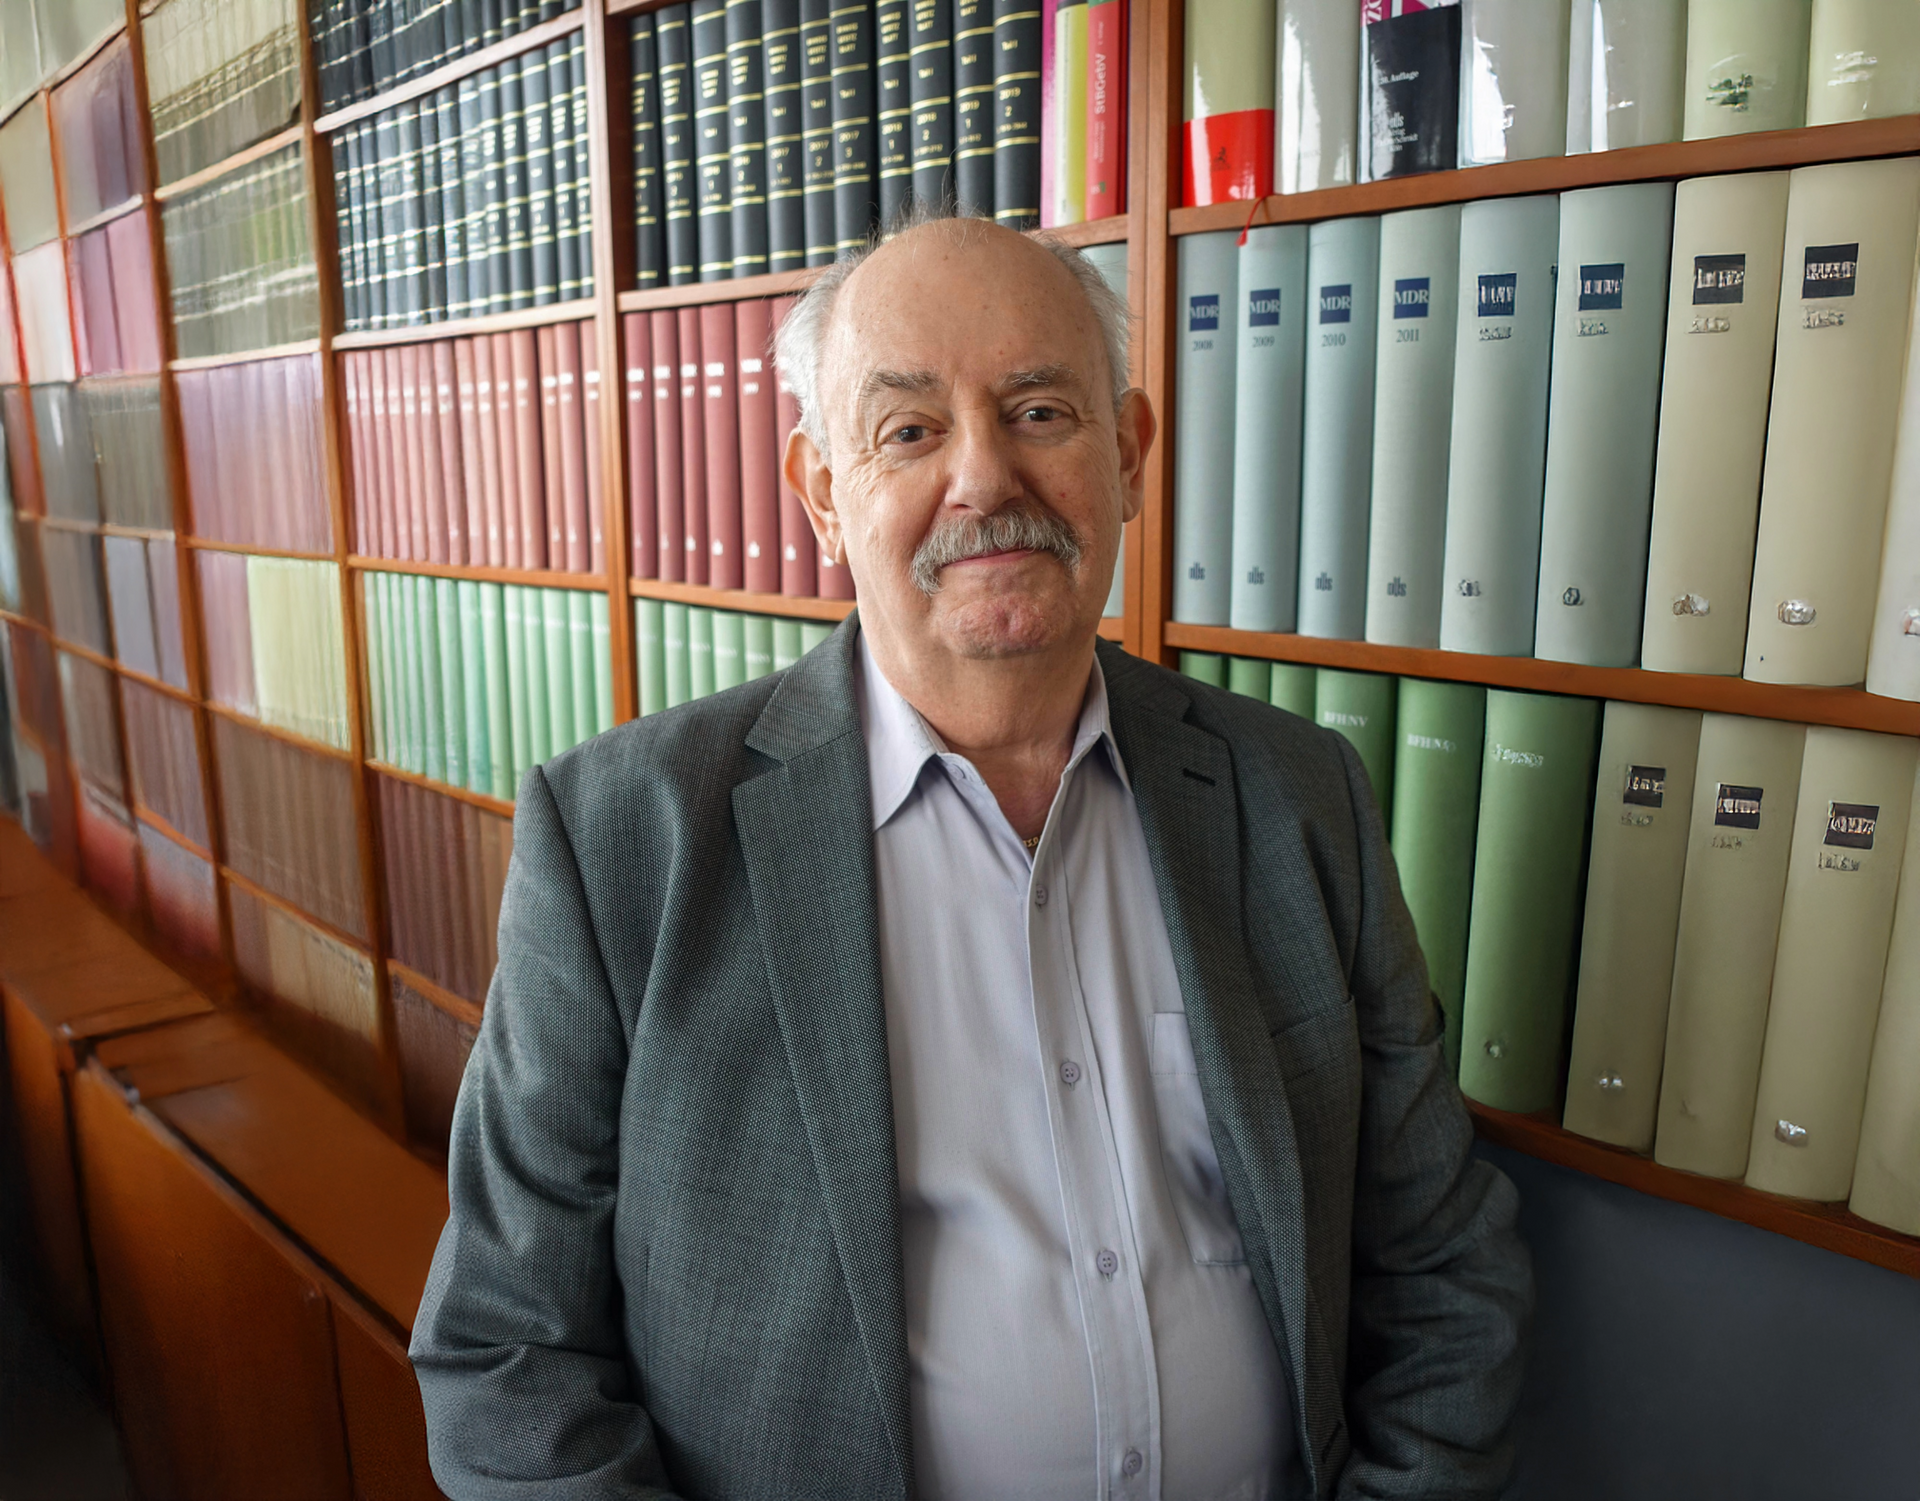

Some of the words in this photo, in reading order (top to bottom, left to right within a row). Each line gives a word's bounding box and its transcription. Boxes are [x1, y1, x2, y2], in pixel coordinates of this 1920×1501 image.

[1320, 296, 1351, 310] MDR
[1394, 289, 1429, 305] MDR
[1190, 305, 1219, 319] MDR
[1249, 299, 1280, 314] MDR
[1252, 336, 1275, 348] 2009
[1321, 333, 1346, 347] 2010
[1396, 329, 1419, 342] 2011
